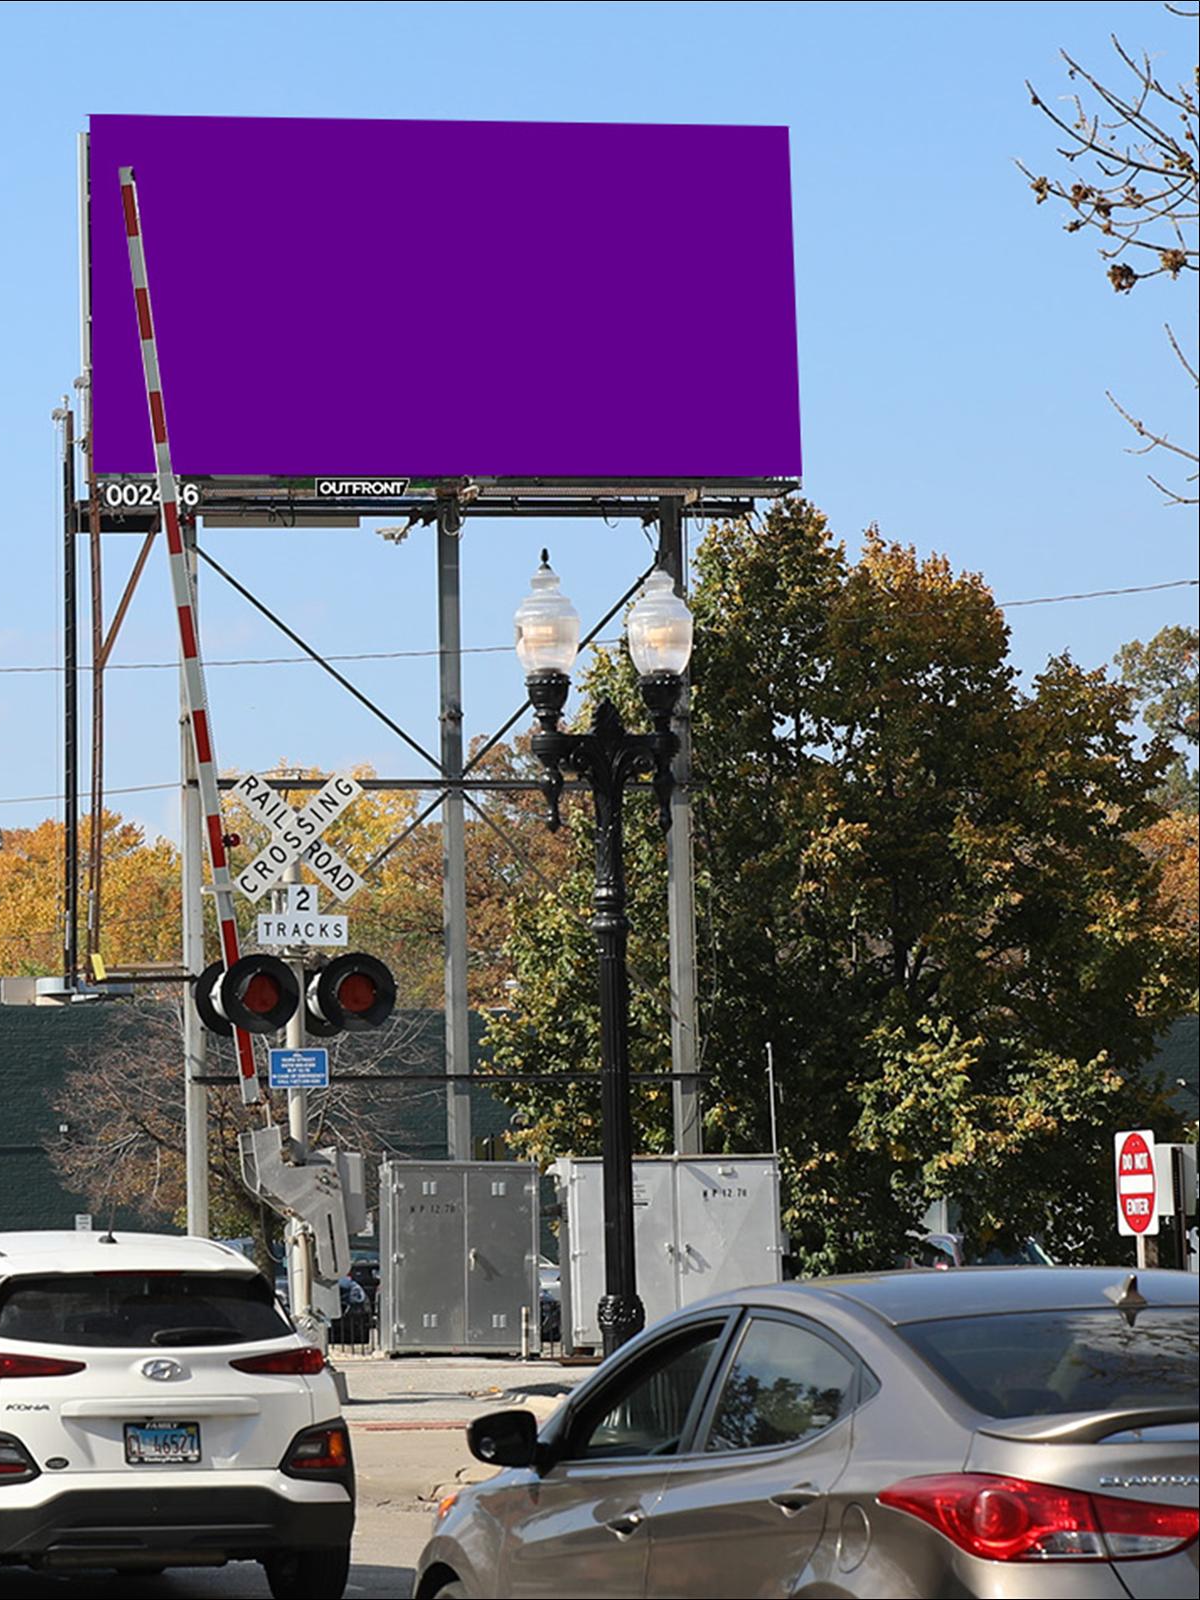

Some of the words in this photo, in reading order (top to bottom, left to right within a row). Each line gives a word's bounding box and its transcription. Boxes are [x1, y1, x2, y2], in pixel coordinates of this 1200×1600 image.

[319, 481, 405, 495] OUTFRONT
[240, 778, 353, 894] CROSSING
[296, 888, 310, 911] 2
[263, 922, 343, 938] TRACKS
[1122, 1153, 1133, 1171] DO
[1133, 1152, 1148, 1169] NOT
[1126, 1198, 1150, 1215] ENTER
